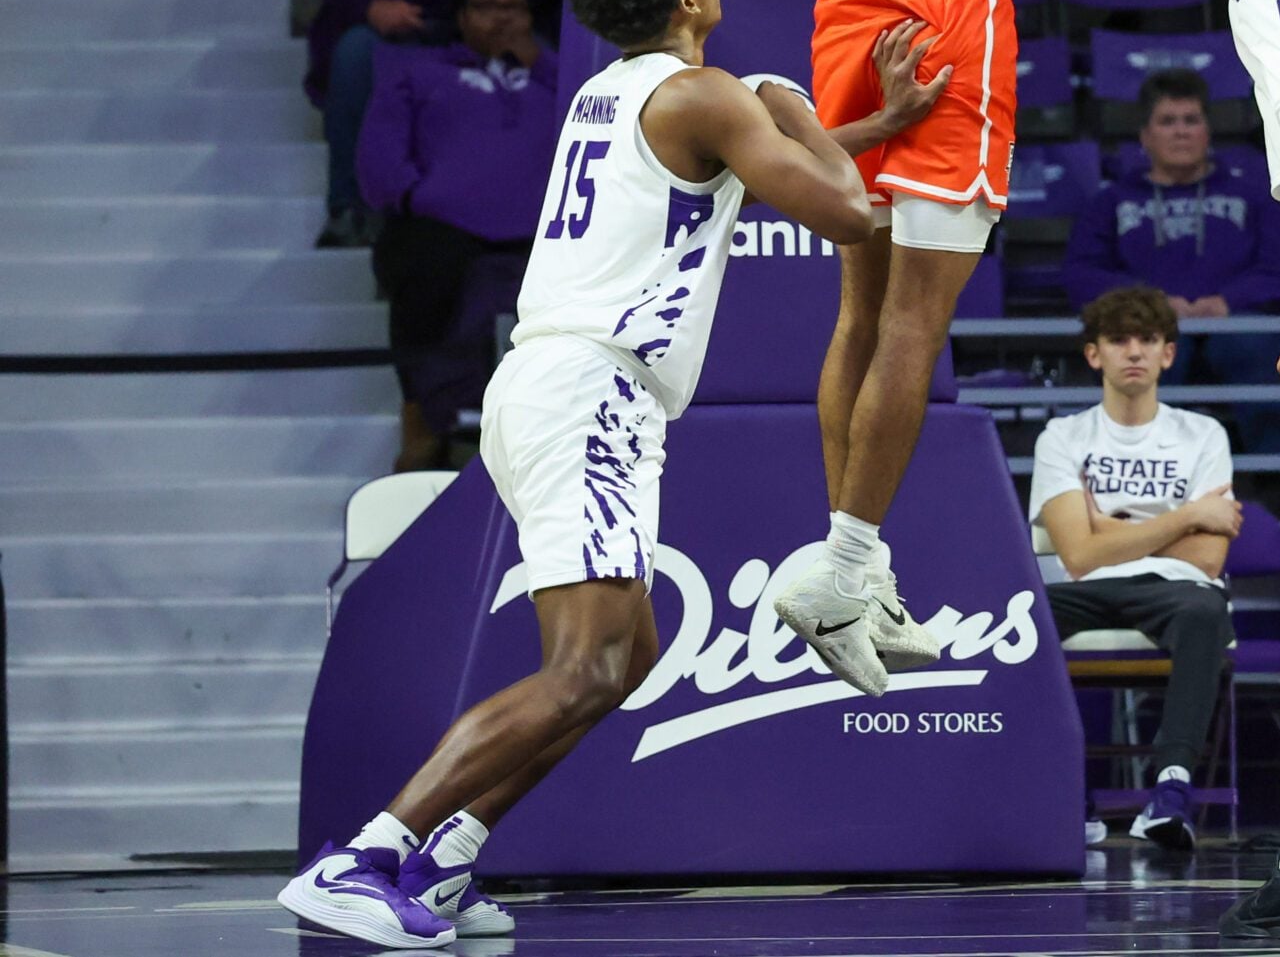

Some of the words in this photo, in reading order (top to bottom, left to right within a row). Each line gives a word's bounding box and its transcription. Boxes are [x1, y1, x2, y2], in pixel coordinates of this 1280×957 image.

[572, 94, 620, 125] MANNING
[544, 140, 612, 240] 15
[490, 540, 1038, 711] Dilns
[842, 712, 910, 734] FOOD
[916, 712, 1004, 734] STORES
